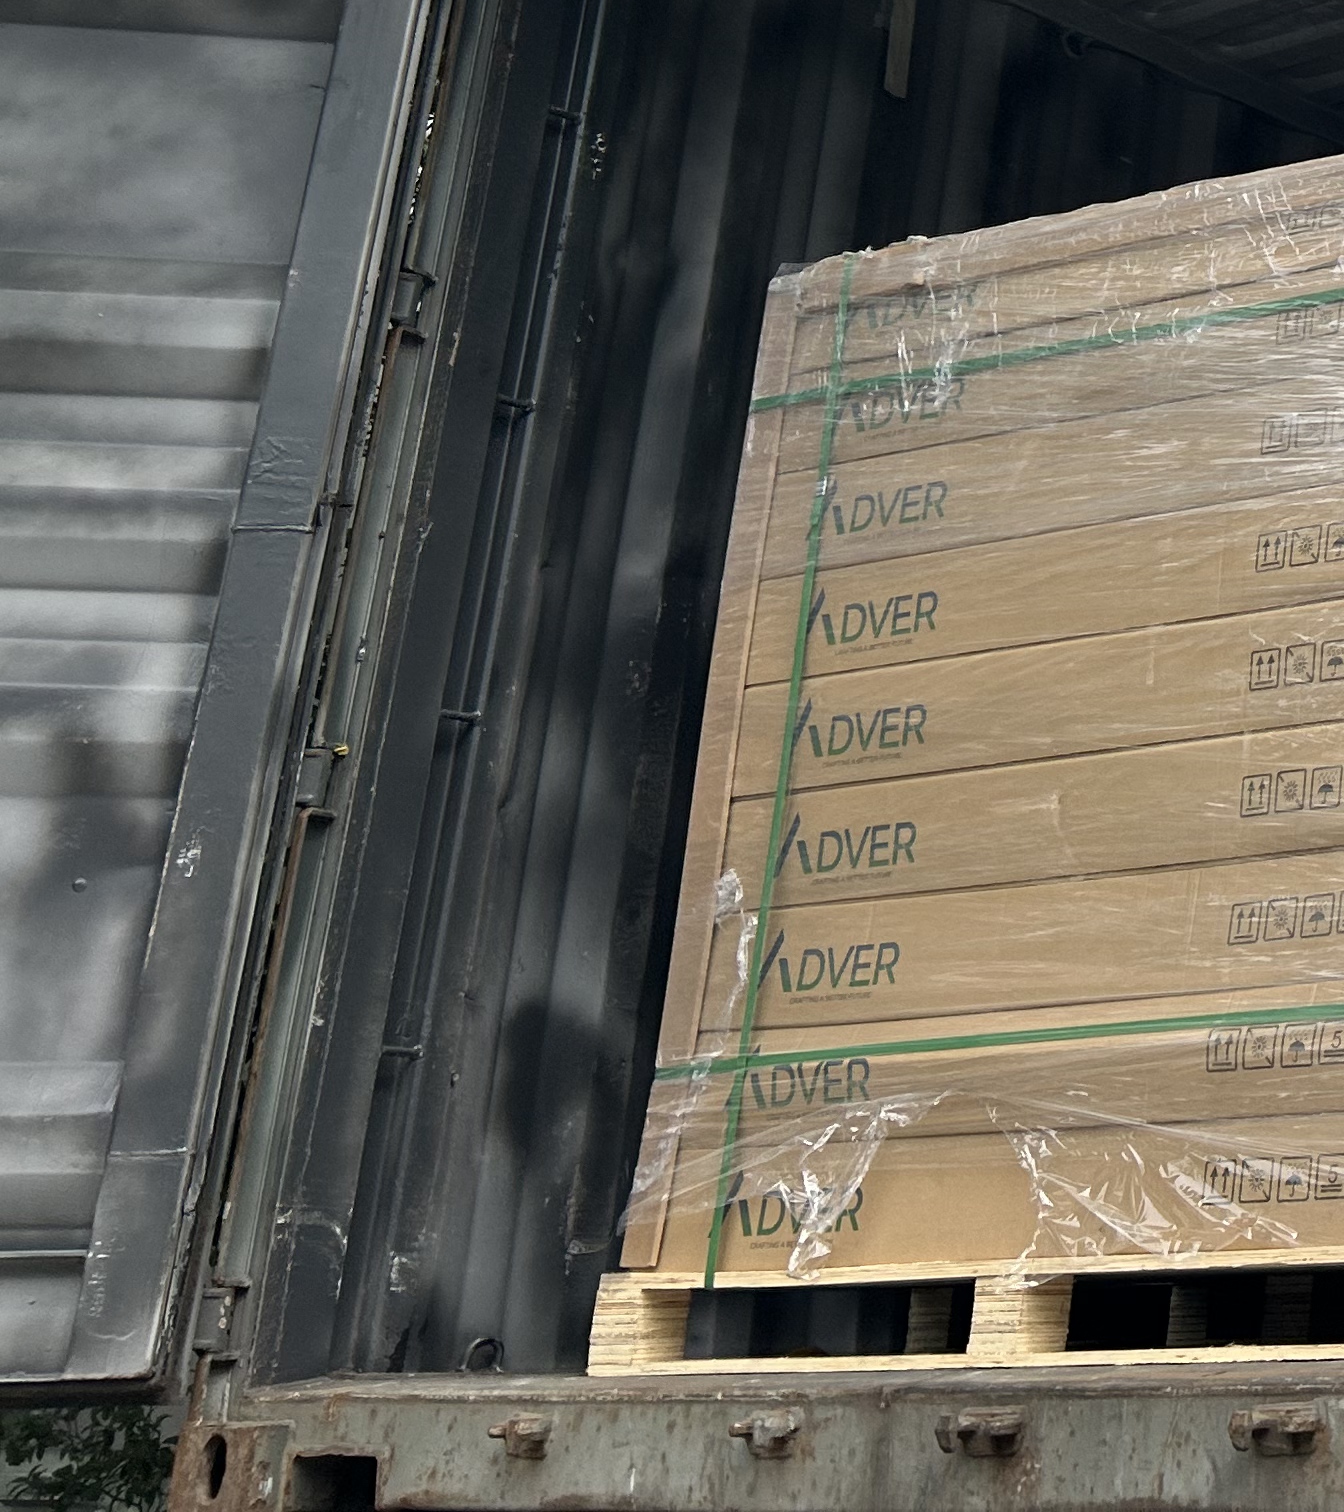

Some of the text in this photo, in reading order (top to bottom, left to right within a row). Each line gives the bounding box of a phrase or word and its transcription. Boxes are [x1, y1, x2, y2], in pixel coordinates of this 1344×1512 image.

[805, 475, 949, 539] ADVER
[806, 587, 939, 646] ADVER
[790, 697, 928, 759] ADVER
[773, 812, 917, 878] ADVER
[757, 928, 901, 993] ADVER
[1331, 1030, 1343, 1049] 5
[725, 1044, 871, 1111] ADVER
